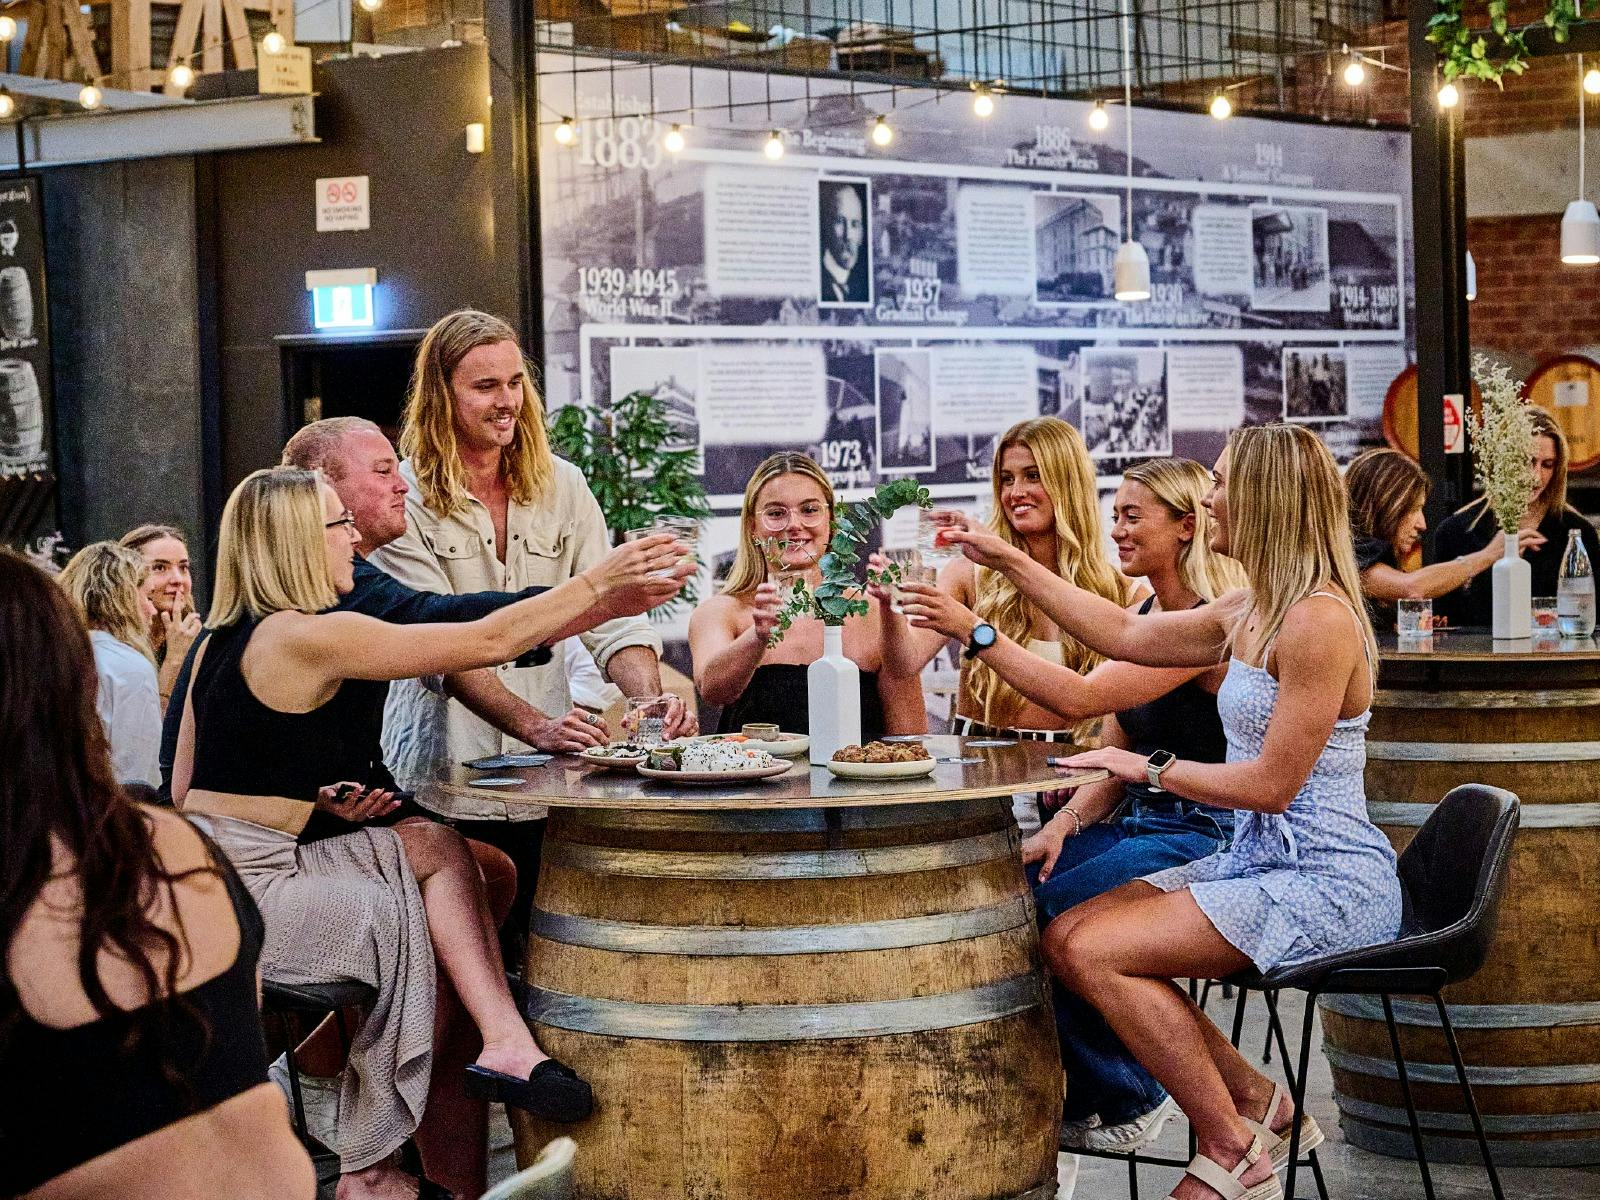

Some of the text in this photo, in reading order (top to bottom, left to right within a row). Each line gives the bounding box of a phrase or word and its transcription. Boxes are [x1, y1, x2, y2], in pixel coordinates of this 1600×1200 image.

[580, 118, 662, 169] 1883
[333, 205, 363, 214] SMOKING
[578, 267, 680, 297] 1939-1945
[904, 278, 941, 309] 1937
[584, 297, 673, 317] World War II
[820, 439, 862, 469] 1973
